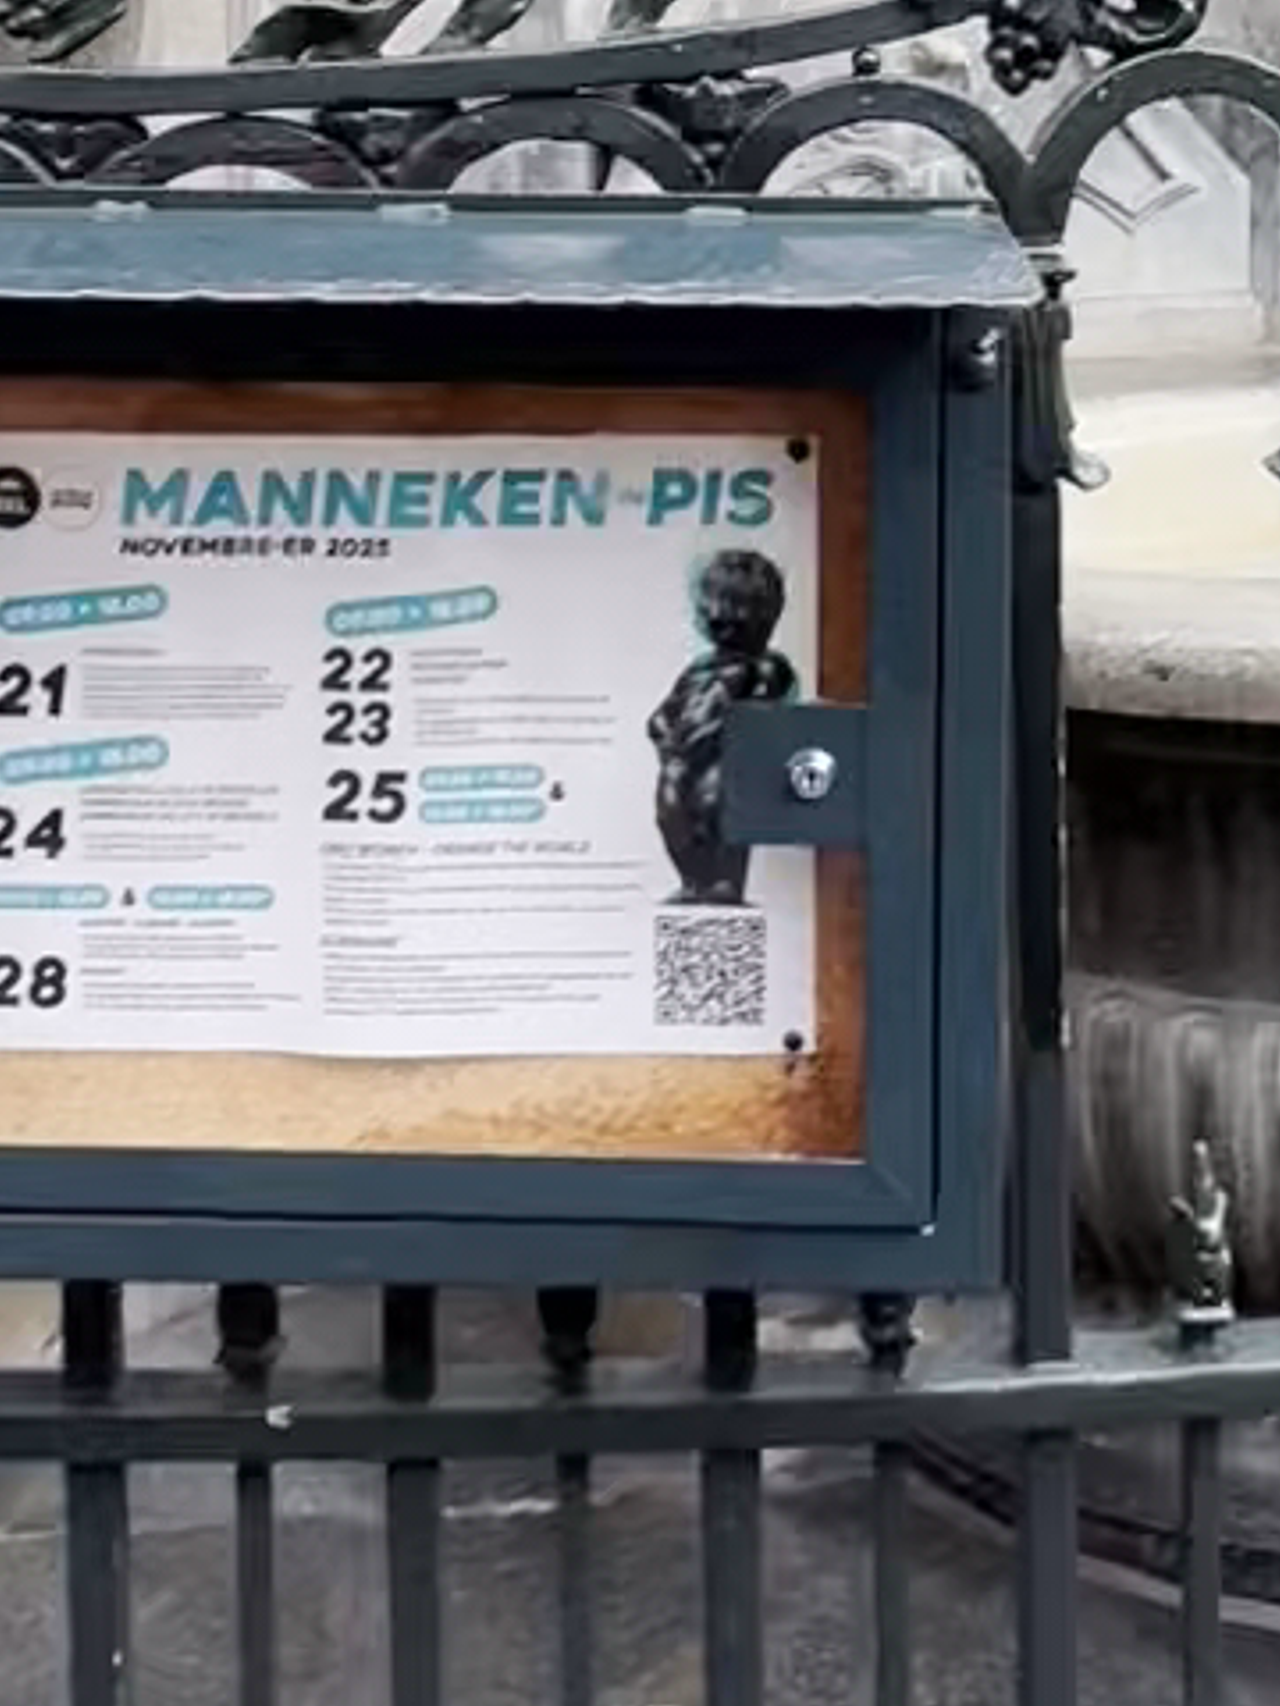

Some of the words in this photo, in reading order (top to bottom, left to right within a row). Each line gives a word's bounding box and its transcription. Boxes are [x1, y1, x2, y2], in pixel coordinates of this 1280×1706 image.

[320, 647, 393, 692] 22
[322, 701, 392, 746] 23
[322, 769, 408, 824] 25
